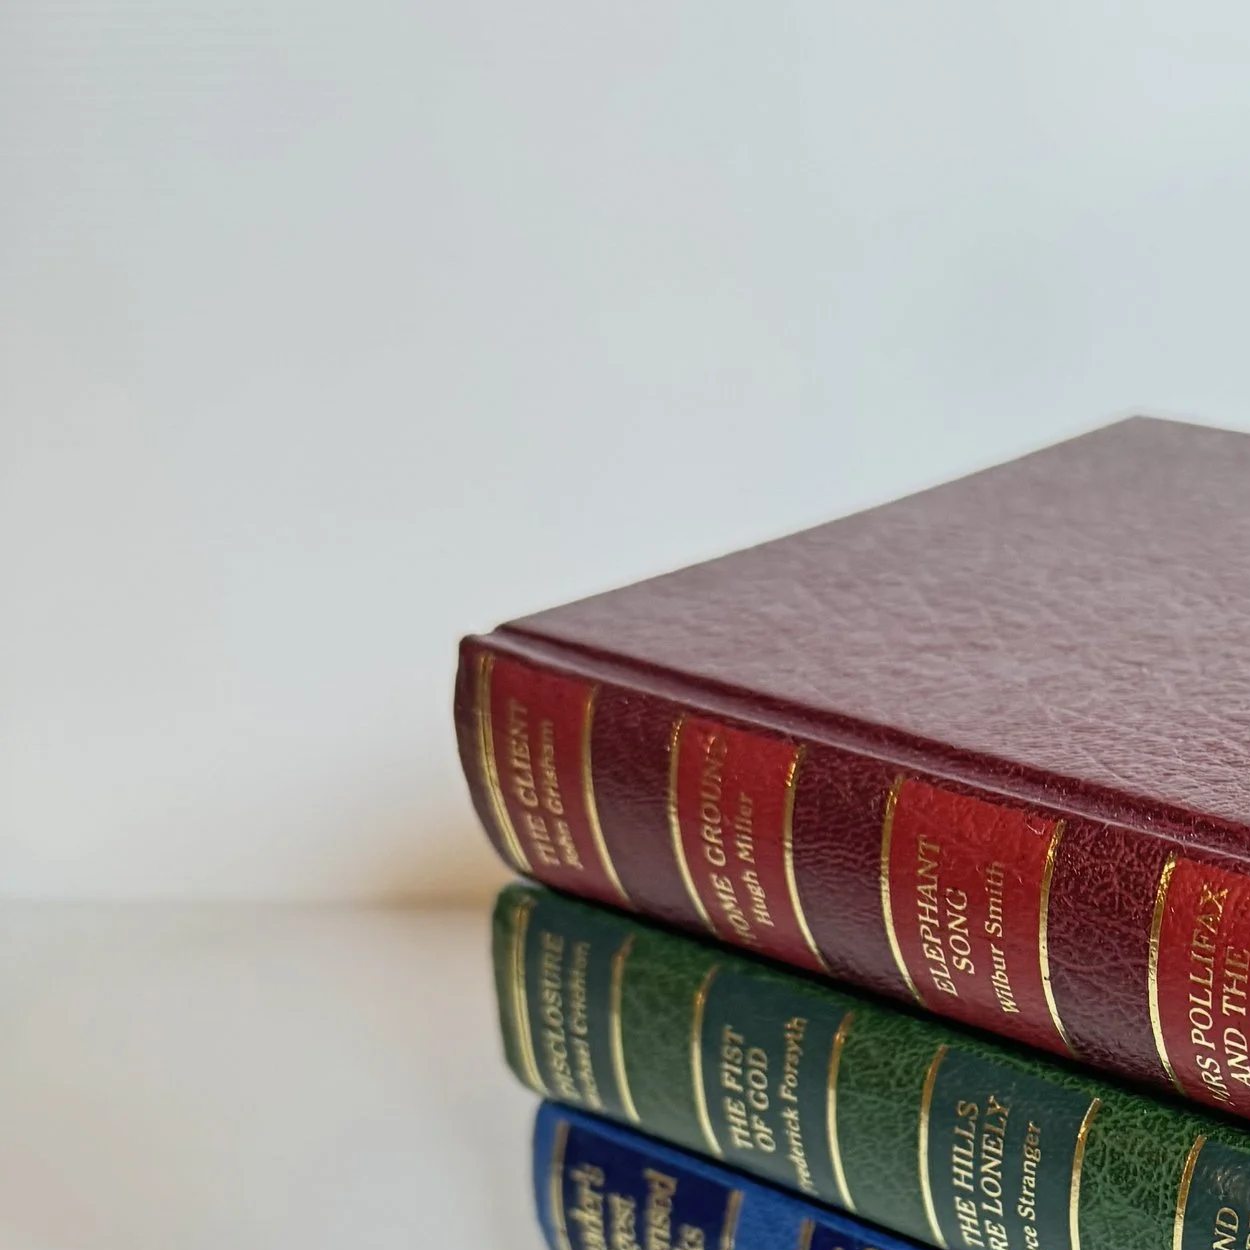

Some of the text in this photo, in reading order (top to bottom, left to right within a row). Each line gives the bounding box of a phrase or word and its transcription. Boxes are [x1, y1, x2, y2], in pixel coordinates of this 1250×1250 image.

[508, 697, 560, 866] THE CLIENT
[540, 720, 564, 815] Grisham
[701, 734, 758, 944] HOME GROUND
[734, 792, 774, 927] Hugh Miller
[917, 834, 958, 996] ELEPHANT
[947, 888, 975, 975] SONG
[984, 860, 1020, 1013] Wilbur Smith
[1189, 882, 1229, 1050] POLLIFAX
[540, 932, 582, 1100] DISCLOSURE
[1221, 945, 1250, 1017] THE
[720, 1024, 754, 1149] THE FIST
[746, 1047, 777, 1152] OF GOD
[780, 1016, 809, 1102] Forsyth
[952, 1100, 984, 1248] THE HILLS
[980, 1095, 1010, 1217] LONELY
[1017, 1120, 1041, 1221] Stranger
